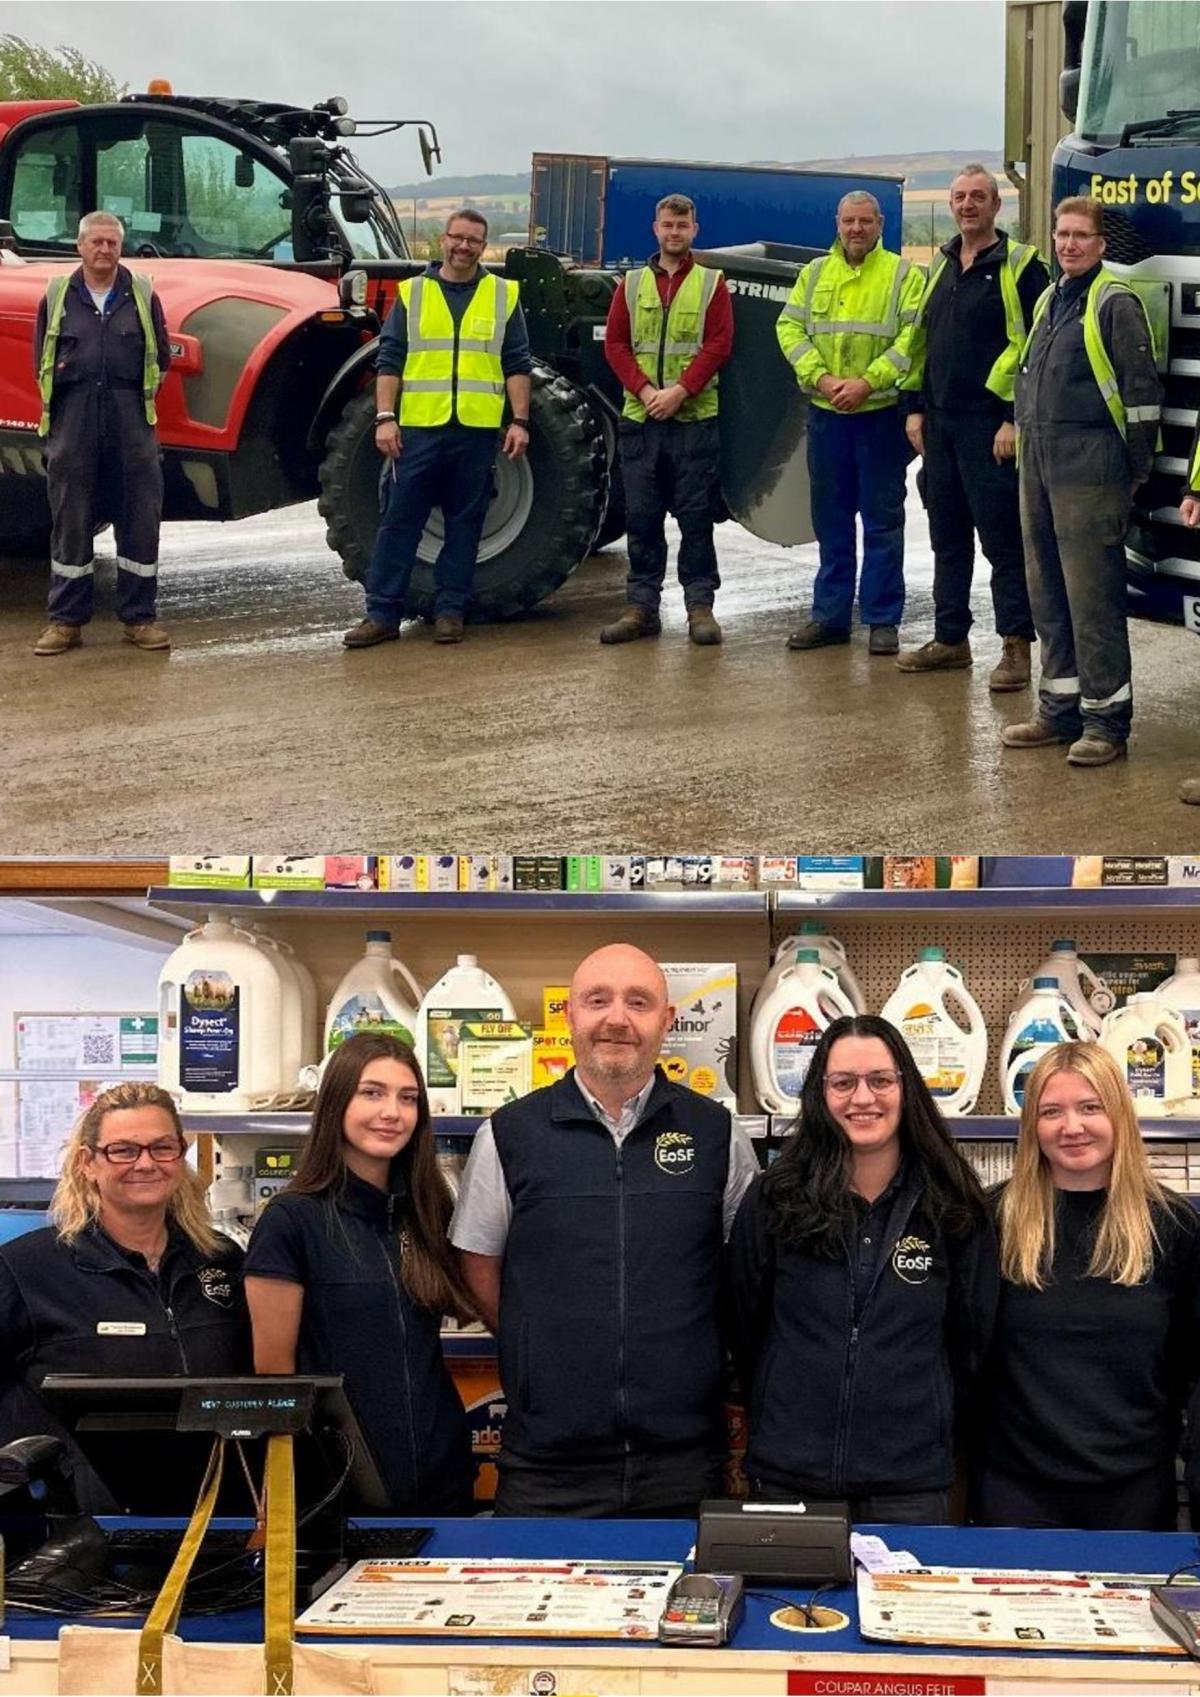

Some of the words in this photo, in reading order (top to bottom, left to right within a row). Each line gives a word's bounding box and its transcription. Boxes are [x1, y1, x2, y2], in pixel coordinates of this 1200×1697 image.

[1090, 174, 1137, 205] East
[1146, 171, 1172, 204] of
[659, 1149, 695, 1162] EoSF
[897, 1255, 933, 1271] EoSF
[814, 1680, 871, 1695] COUPAR
[872, 1682, 923, 1696] ANGUS
